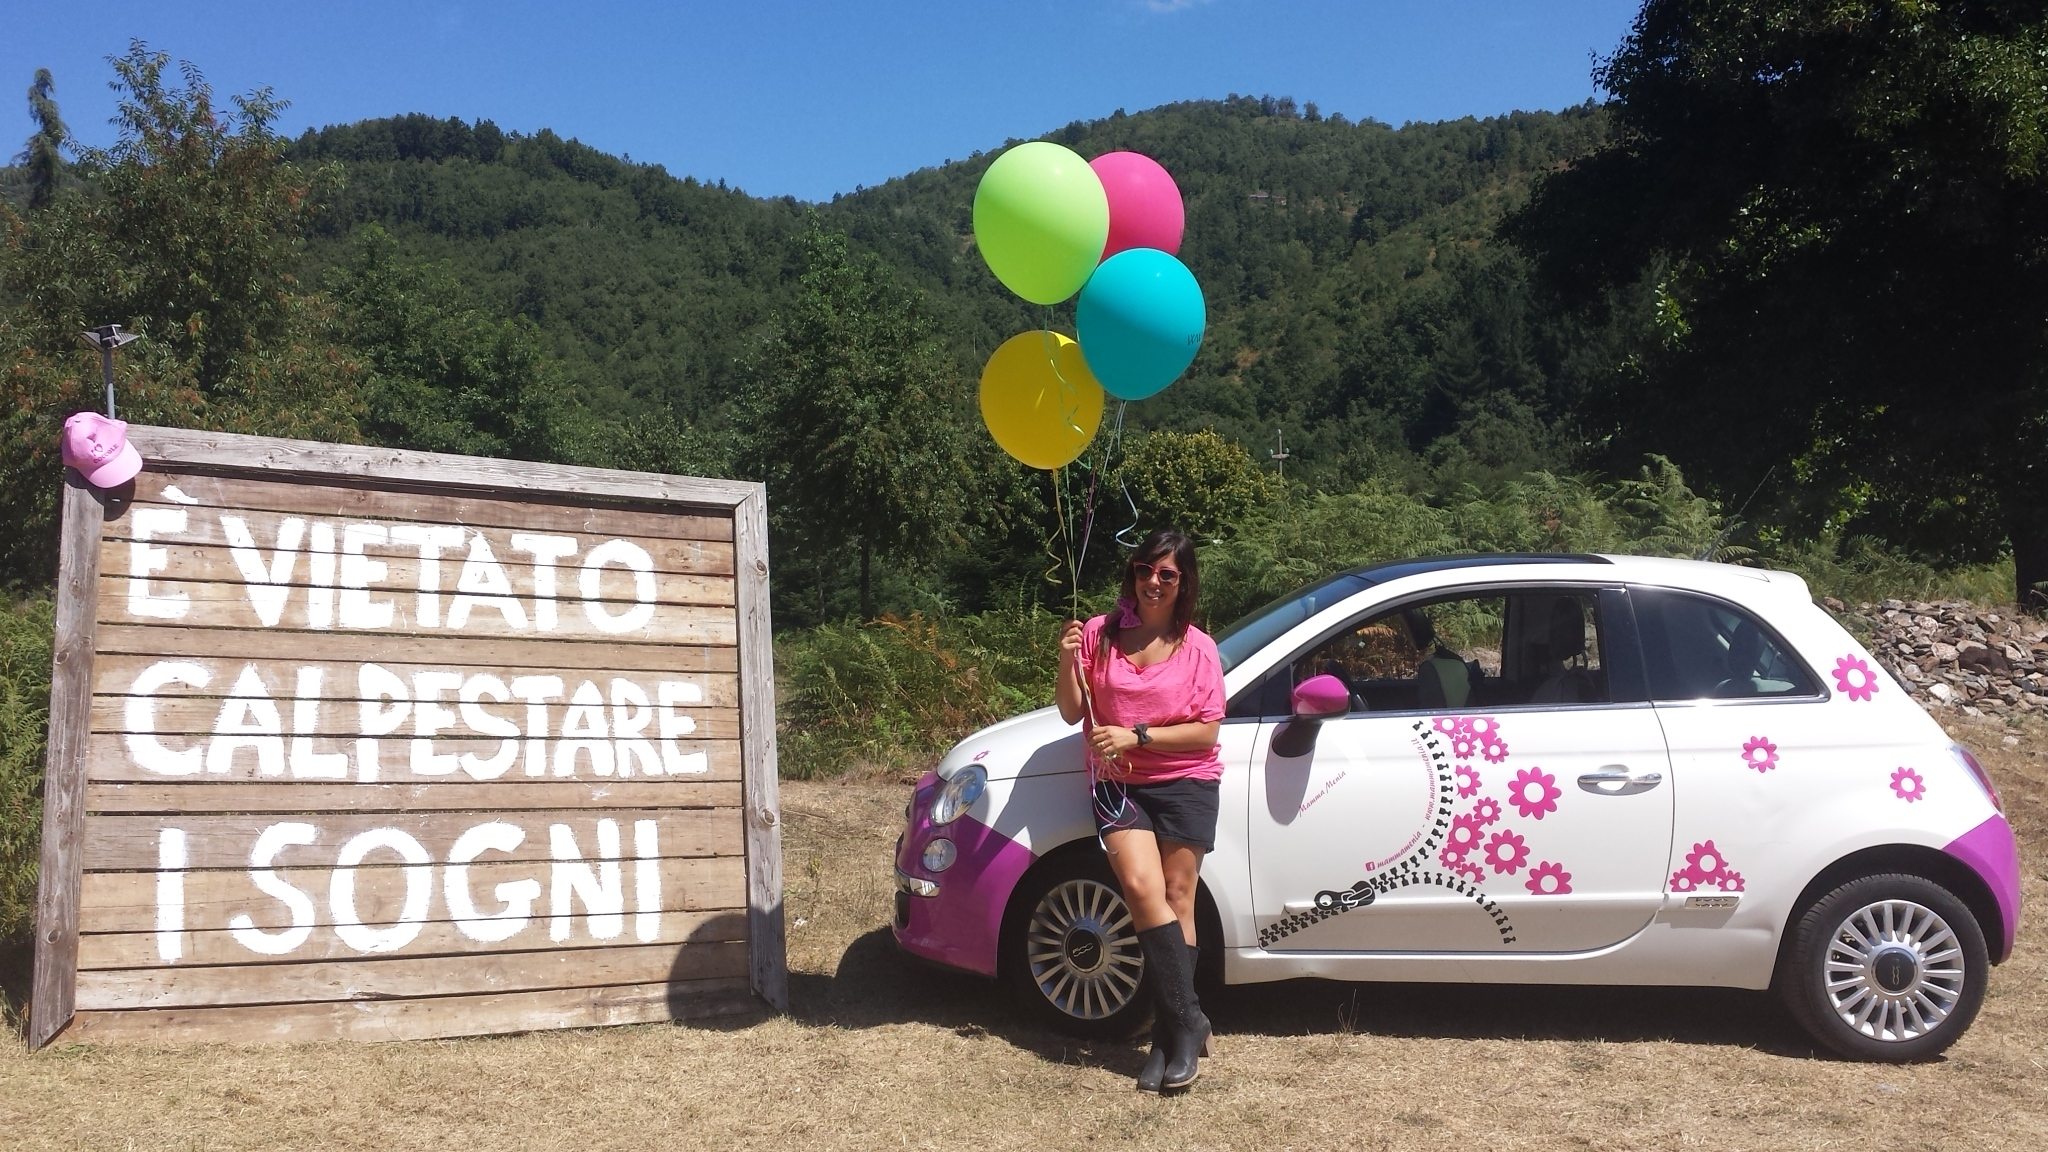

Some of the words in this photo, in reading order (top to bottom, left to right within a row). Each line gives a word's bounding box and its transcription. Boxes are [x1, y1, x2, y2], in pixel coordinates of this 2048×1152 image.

[128, 484, 198, 619] È
[221, 516, 657, 633] VIETATO
[124, 660, 708, 782] CALPESTARE
[1299, 789, 1325, 818] Mamma
[1325, 771, 1346, 794] Menia
[1377, 831, 1422, 868] mammamenia
[156, 827, 188, 962] I
[229, 819, 661, 954] SOGNI
